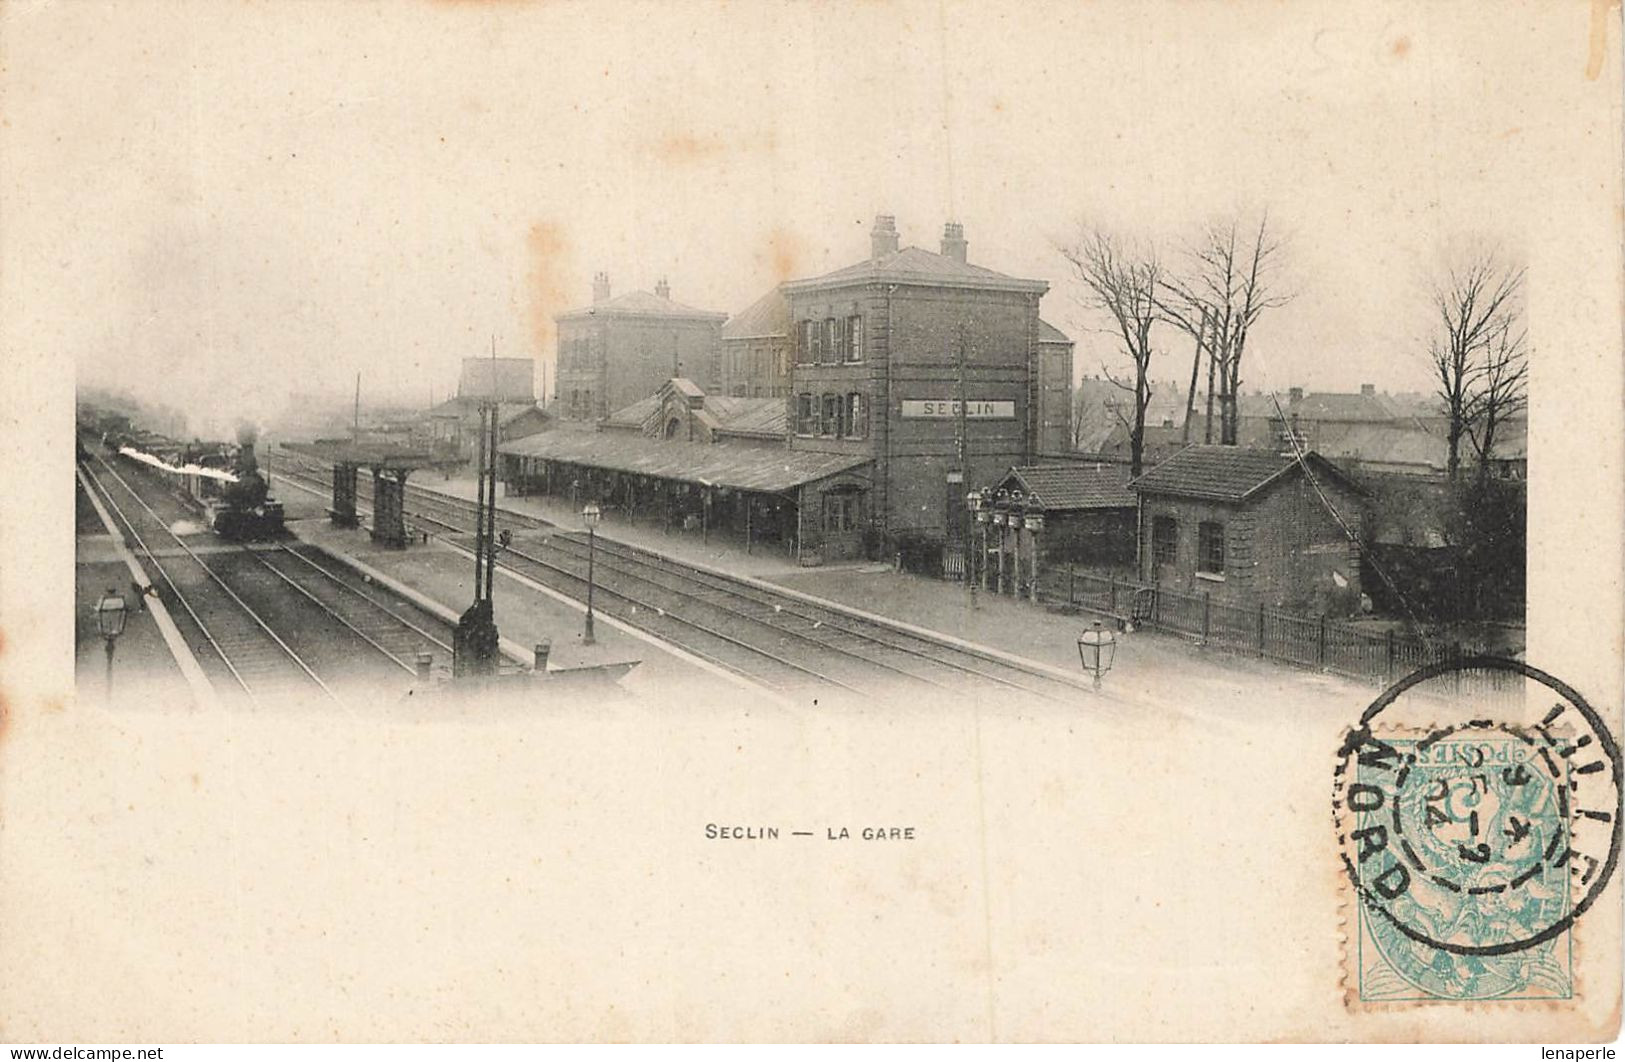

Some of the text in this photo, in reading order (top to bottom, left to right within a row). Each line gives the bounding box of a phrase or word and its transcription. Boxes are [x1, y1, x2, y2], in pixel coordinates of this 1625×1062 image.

[923, 402, 995, 415] SECLIN
[1346, 728, 1411, 900] NORD
[705, 823, 779, 839] SECLIN
[827, 827, 850, 840] LA
[861, 827, 915, 840] GARE
